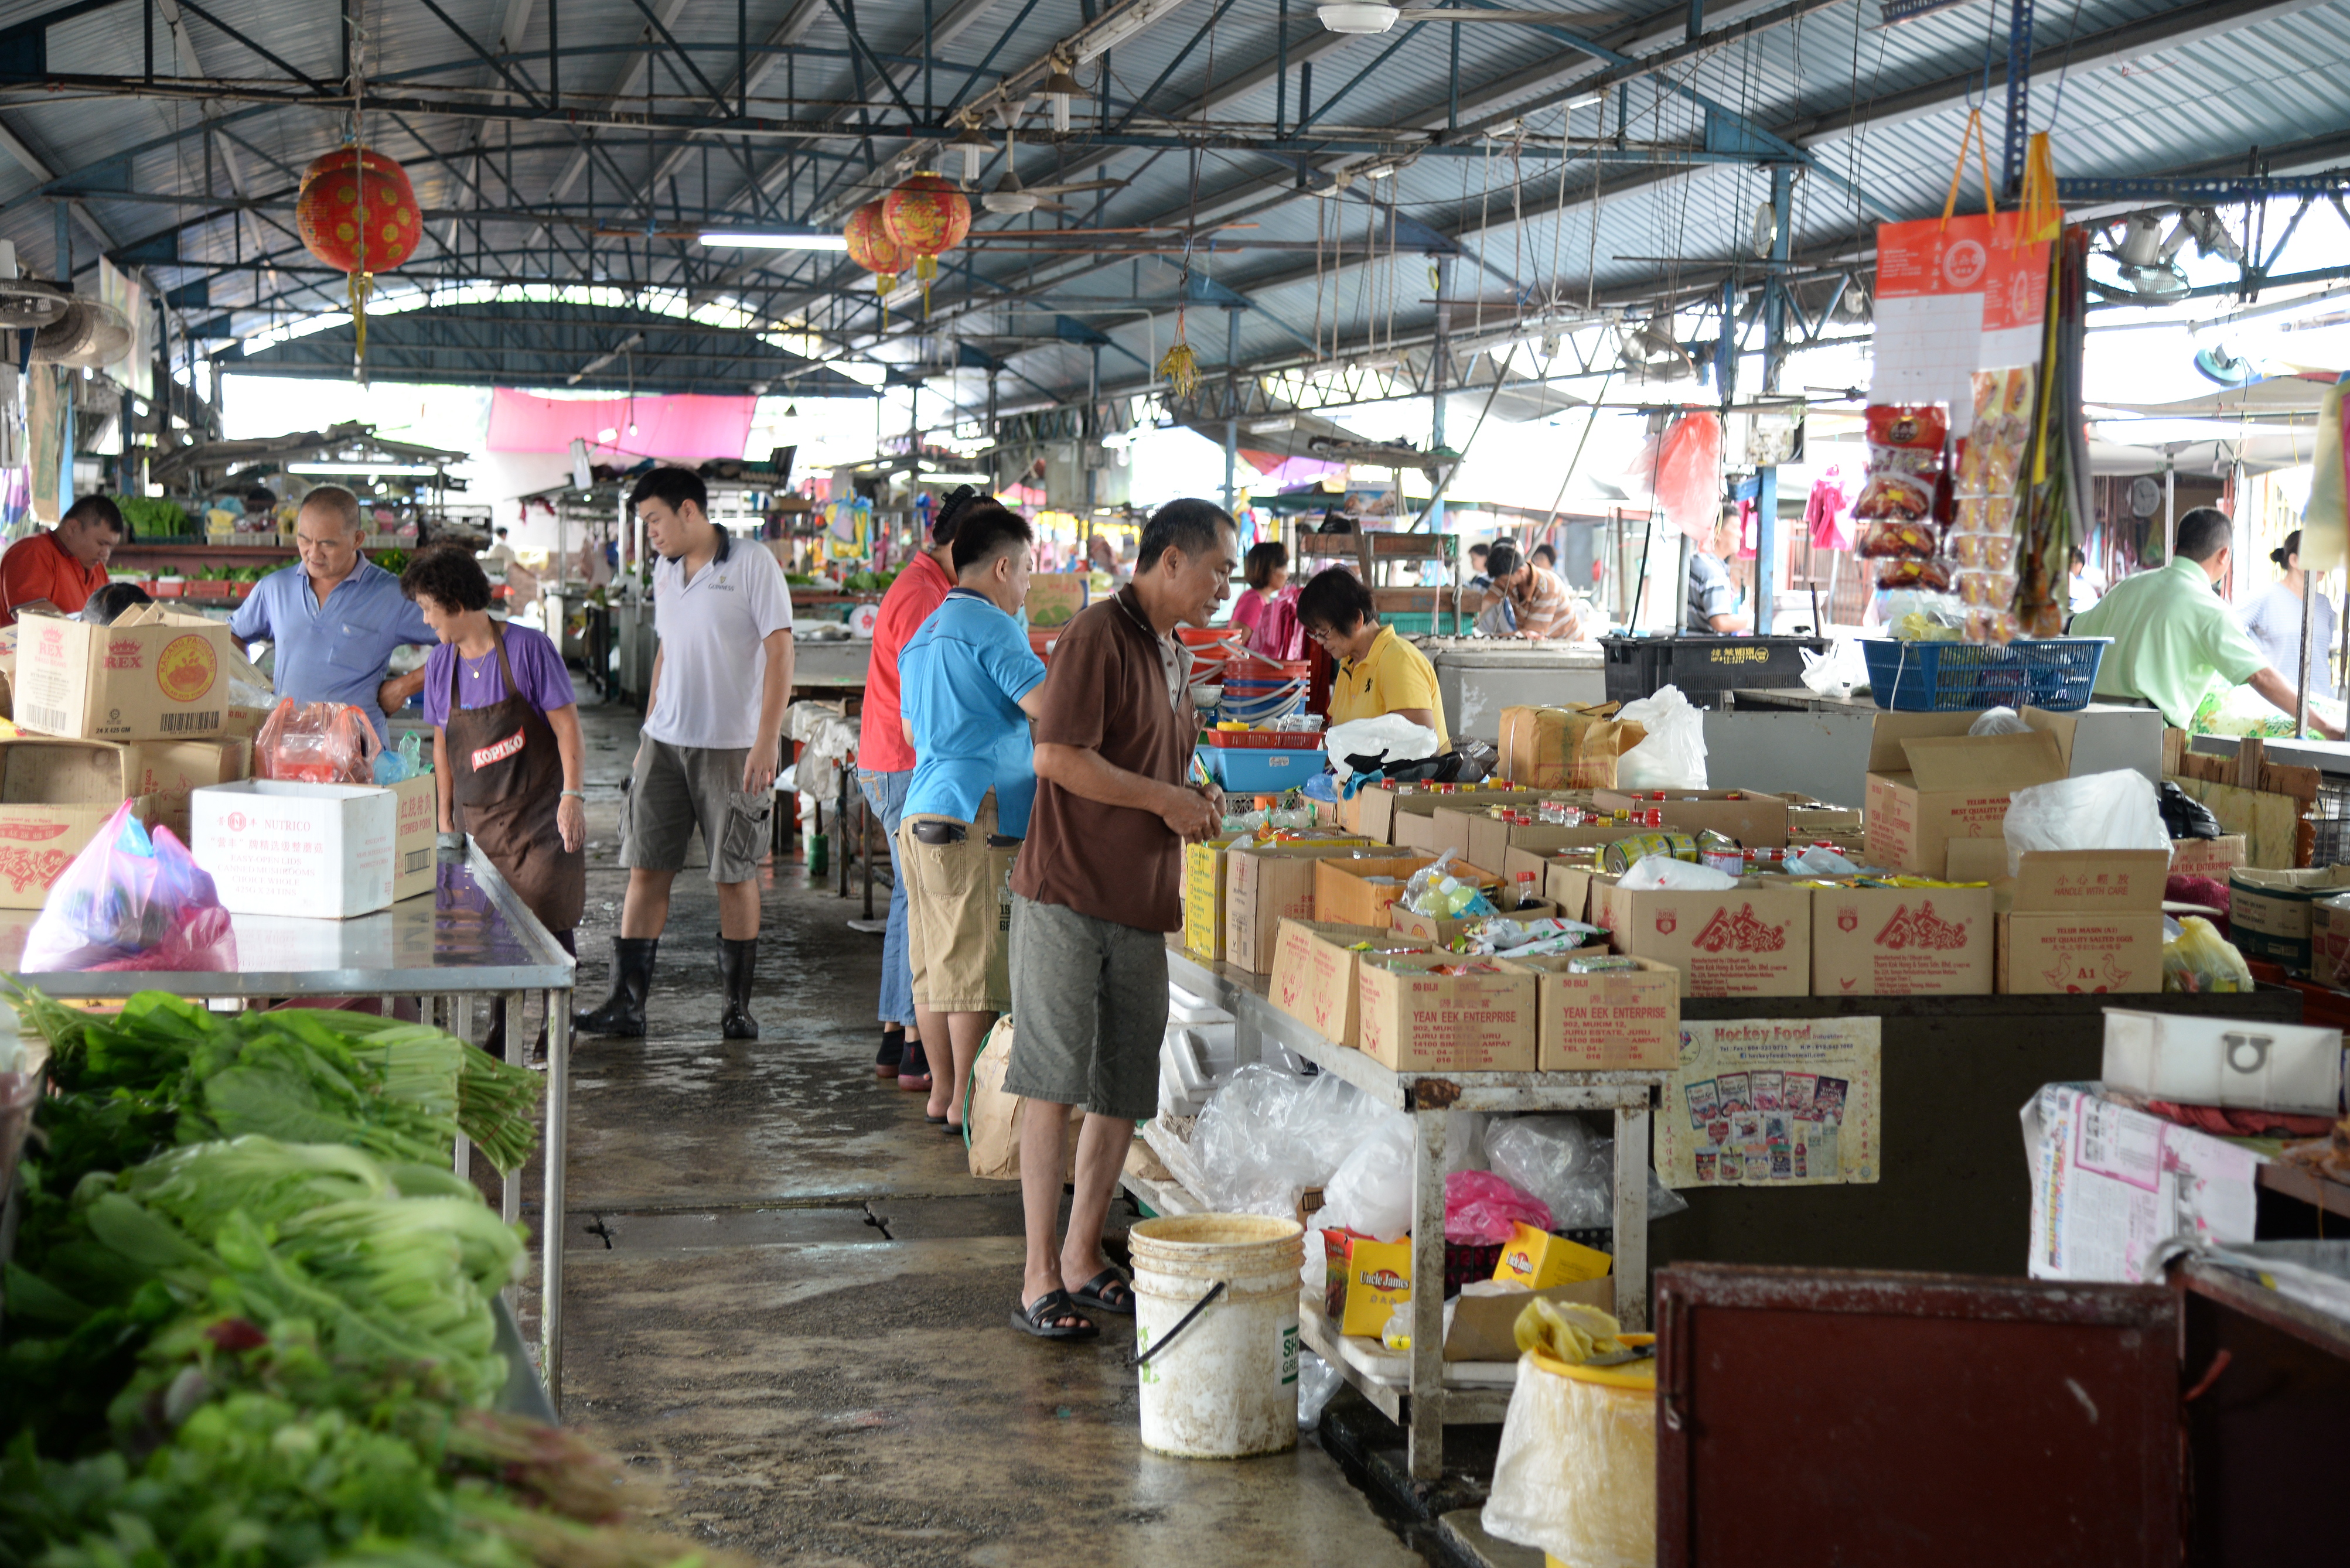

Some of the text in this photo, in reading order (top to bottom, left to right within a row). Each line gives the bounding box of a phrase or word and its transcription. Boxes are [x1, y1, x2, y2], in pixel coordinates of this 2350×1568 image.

[708, 583, 734, 592] GUINNESS
[39, 642, 64, 658] REX
[160, 637, 214, 673] KACANG PANGGANG
[50, 659, 67, 668] BEANS
[103, 657, 143, 669] REX
[163, 682, 178, 696] DALAM
[235, 711, 247, 719] BIJI
[474, 735, 523, 766] KOPIKO
[401, 791, 432, 820] 红烧猪肉
[265, 819, 311, 832] NUTRICO
[400, 817, 432, 836] STEWED PORK
[231, 855, 302, 866] EASY-OPEN LIDS
[218, 864, 315, 877] CANNED MUSHROOMS
[2181, 862, 2232, 872] EEK ENTERPRISE
[232, 875, 300, 887] CHOICE WHOLE
[2057, 874, 2130, 886] 小心輕放
[236, 886, 256, 894] 425G
[275, 888, 296, 896] TINS
[2054, 887, 2129, 896] HANDLE WITH CARE
[1716, 964, 1729, 972] Hong
[1899, 961, 1912, 969] Hong
[2078, 968, 2096, 979] A1
[1413, 983, 1422, 992] 50
[1424, 983, 1438, 992] BIJI
[1563, 979, 1588, 988] 50 BIJI
[1413, 1011, 1516, 1023] YEAN EEK ENTERPRISE
[1563, 1007, 1666, 1019] YEAN EEK ENTERPRISE
[1714, 1026, 1769, 1043] Hockey
[1774, 1025, 1811, 1040] Food
[1506, 1251, 1533, 1274] Uncle James
[1360, 1270, 1410, 1290] Uncle James
